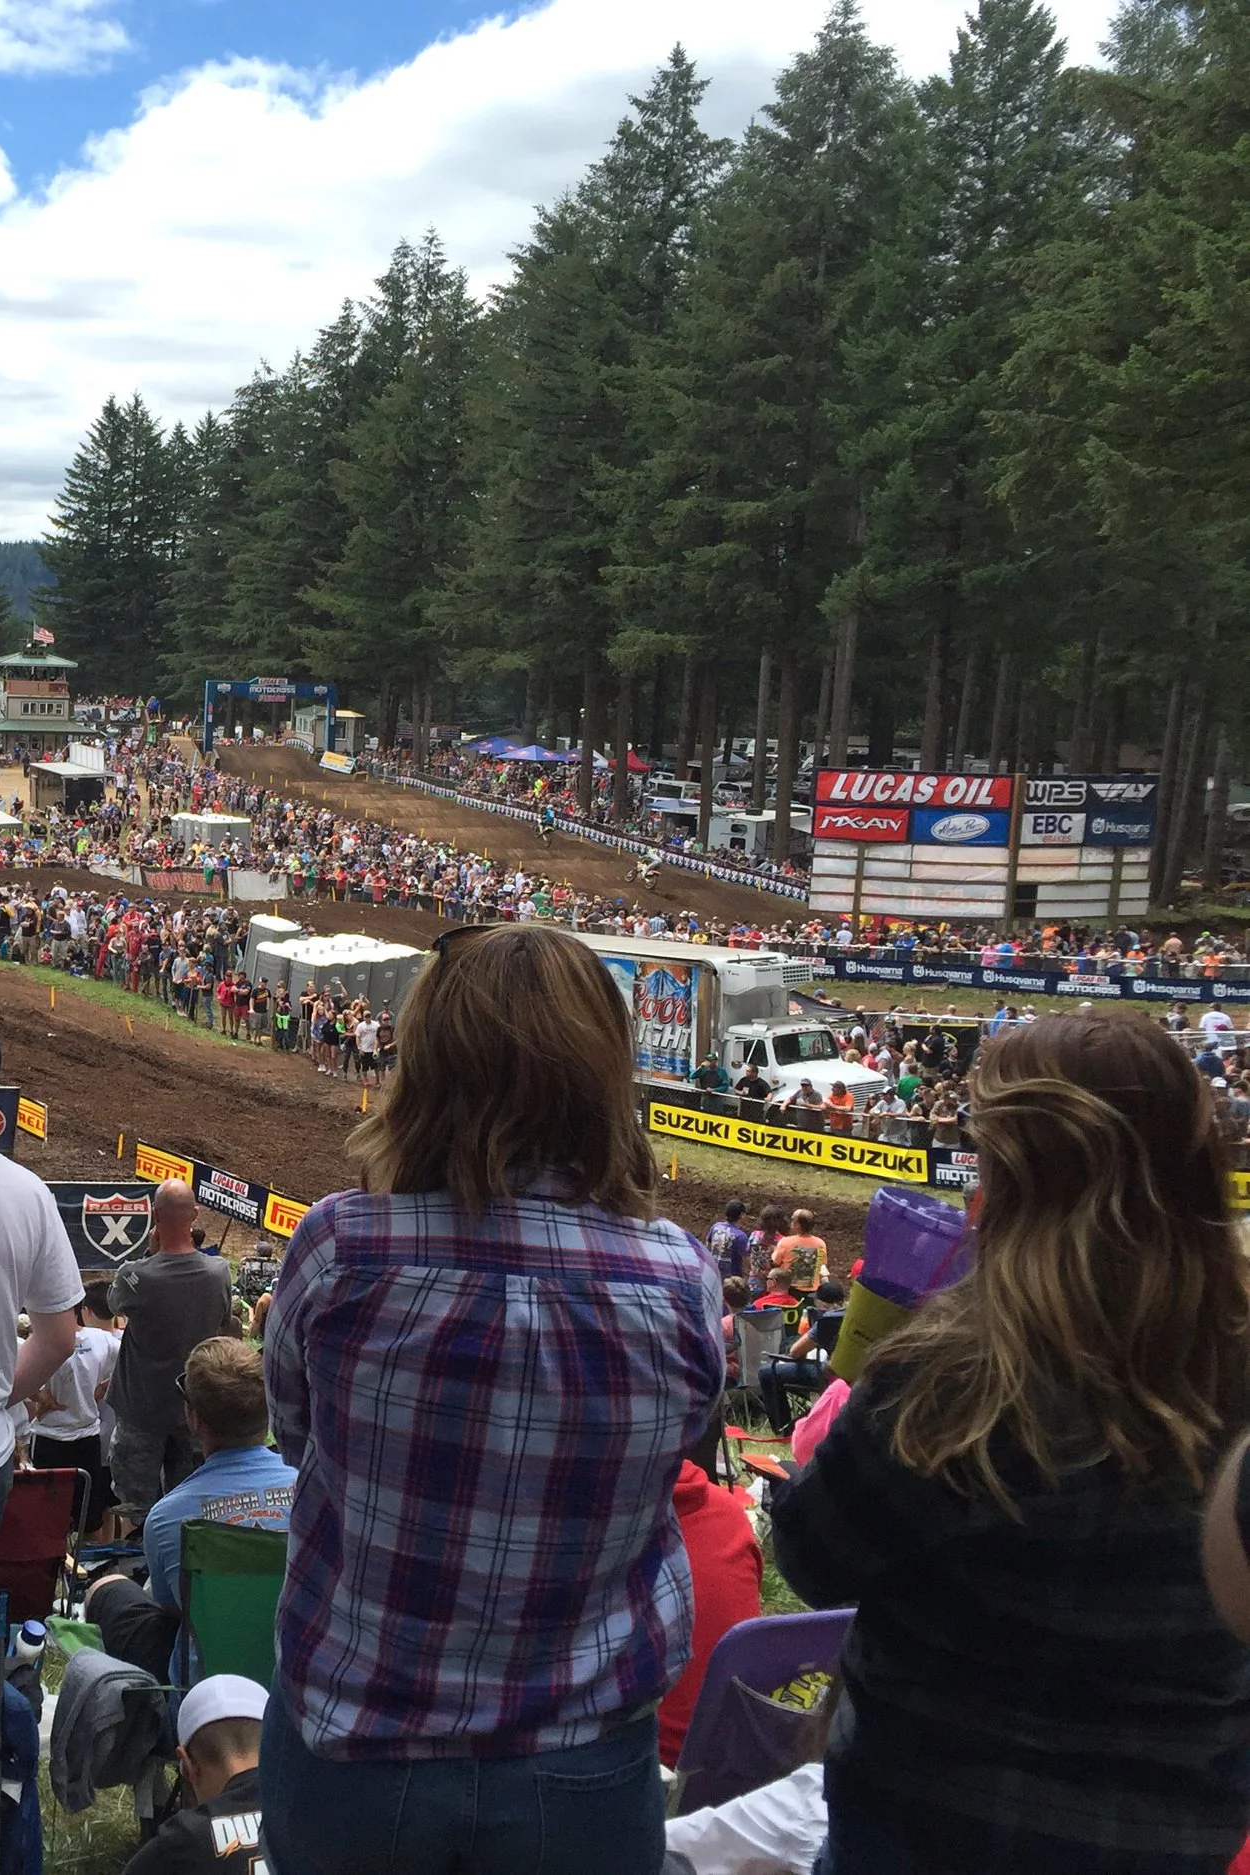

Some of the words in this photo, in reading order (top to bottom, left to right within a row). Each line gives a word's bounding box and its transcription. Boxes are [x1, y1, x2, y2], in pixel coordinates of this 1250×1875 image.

[250, 686, 296, 694] MOTOCROSS
[830, 773, 938, 804] LUCAS
[943, 777, 995, 805] OIL
[1025, 780, 1087, 806] WPS
[1032, 815, 1073, 834] EBC
[857, 964, 904, 976] Husqvarna
[925, 968, 973, 981] Husqvarna
[994, 973, 1045, 986] Husqvarna
[1057, 984, 1122, 994] MOTOCROSS
[1146, 984, 1200, 996] Husqvarna
[637, 1022, 692, 1050] IGHT
[653, 1110, 729, 1139] SUZUKI
[737, 1128, 822, 1157] SUZUKI
[831, 1144, 923, 1175] SUZUKI
[213, 1173, 234, 1190] LUCAS
[235, 1182, 247, 1195] OIL
[89, 1203, 145, 1212] RACER
[199, 1185, 258, 1219] MOTOCROSS
[100, 1215, 133, 1246] X
[200, 1491, 260, 1520] DAYTONA
